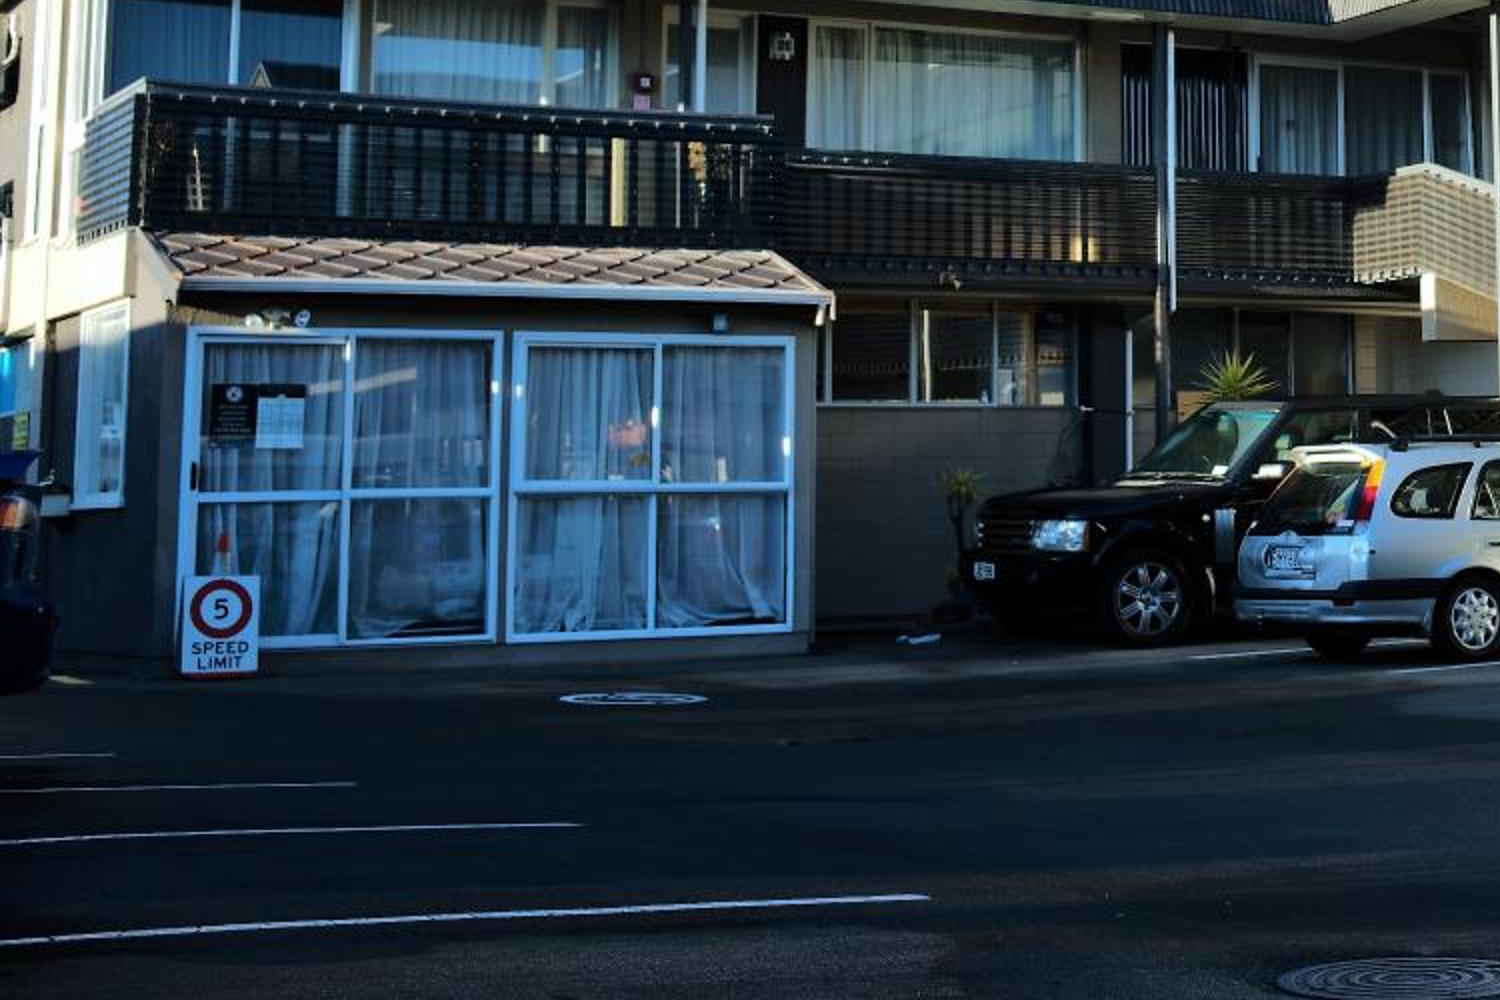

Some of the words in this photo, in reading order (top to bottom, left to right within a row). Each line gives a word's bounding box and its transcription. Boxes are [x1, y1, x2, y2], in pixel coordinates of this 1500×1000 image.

[213, 598, 229, 619] 5
[191, 641, 249, 655] SPEED
[197, 656, 242, 670] LIMIT
